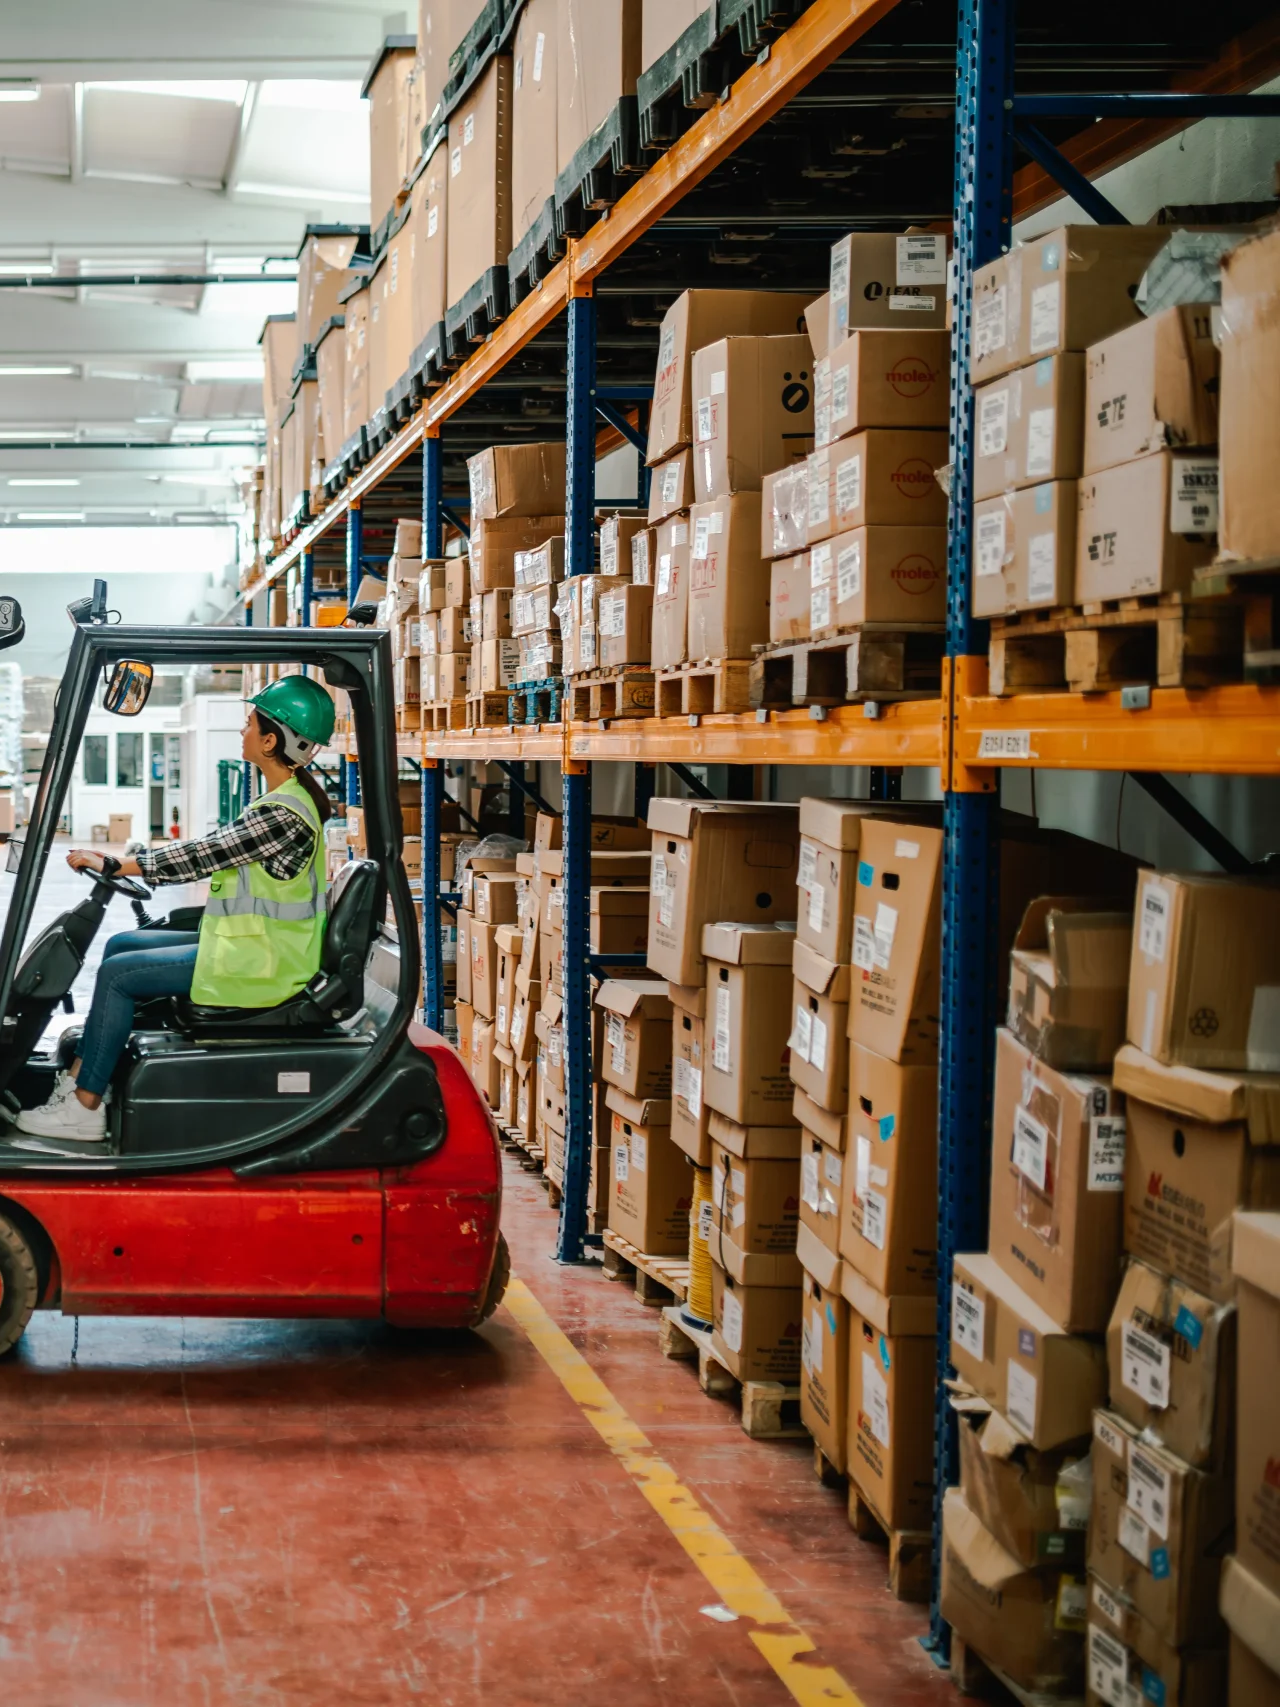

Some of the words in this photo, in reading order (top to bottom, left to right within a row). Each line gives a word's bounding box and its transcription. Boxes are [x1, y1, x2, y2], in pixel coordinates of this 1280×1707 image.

[886, 286, 921, 297] LEAR
[885, 368, 936, 383] molex
[890, 566, 939, 580] molex
